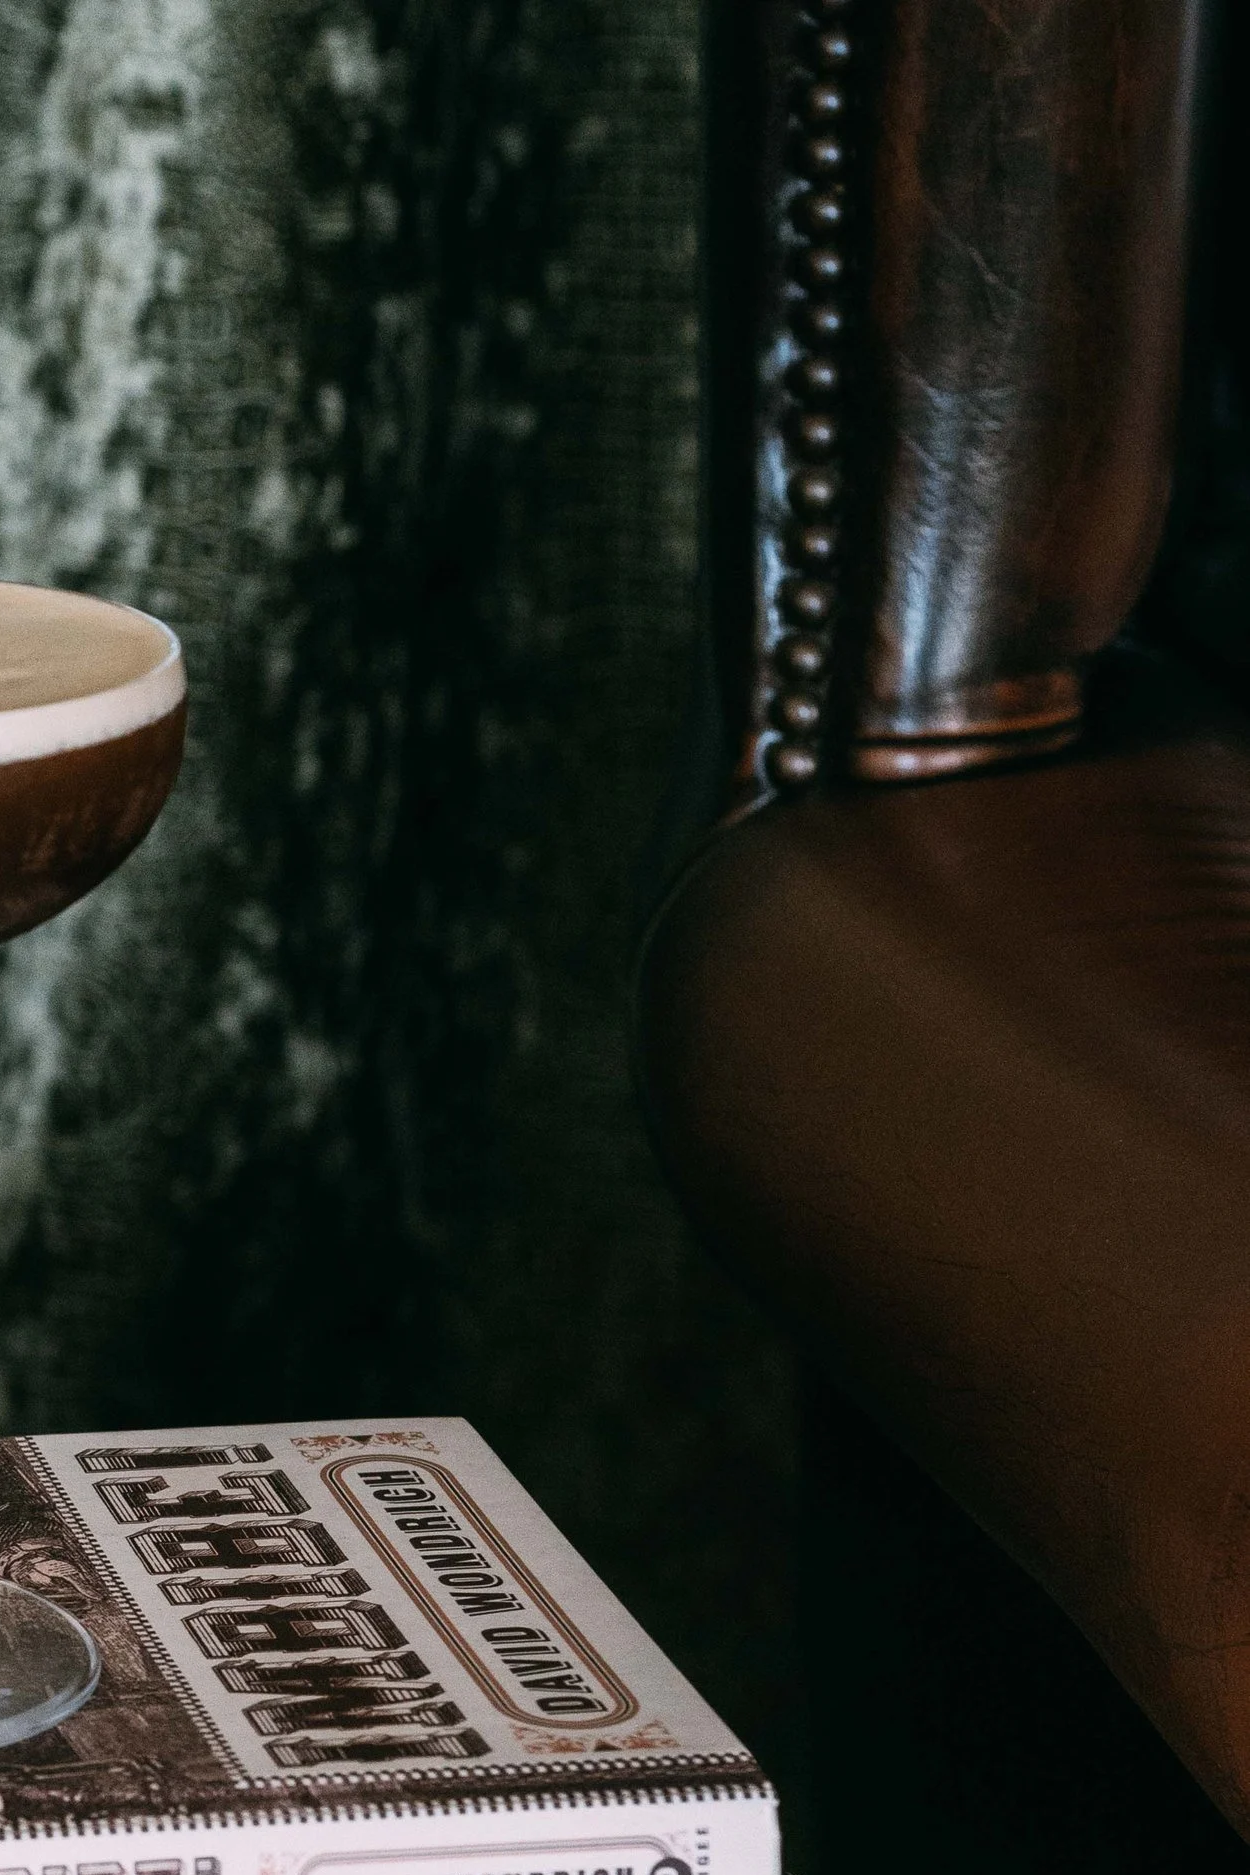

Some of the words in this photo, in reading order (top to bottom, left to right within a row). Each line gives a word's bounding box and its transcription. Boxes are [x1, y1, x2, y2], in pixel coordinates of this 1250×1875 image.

[74, 1442, 492, 1768] IMBIBE!
[359, 1470, 528, 1617] WONDRICH
[481, 1625, 607, 1714] DAVID
